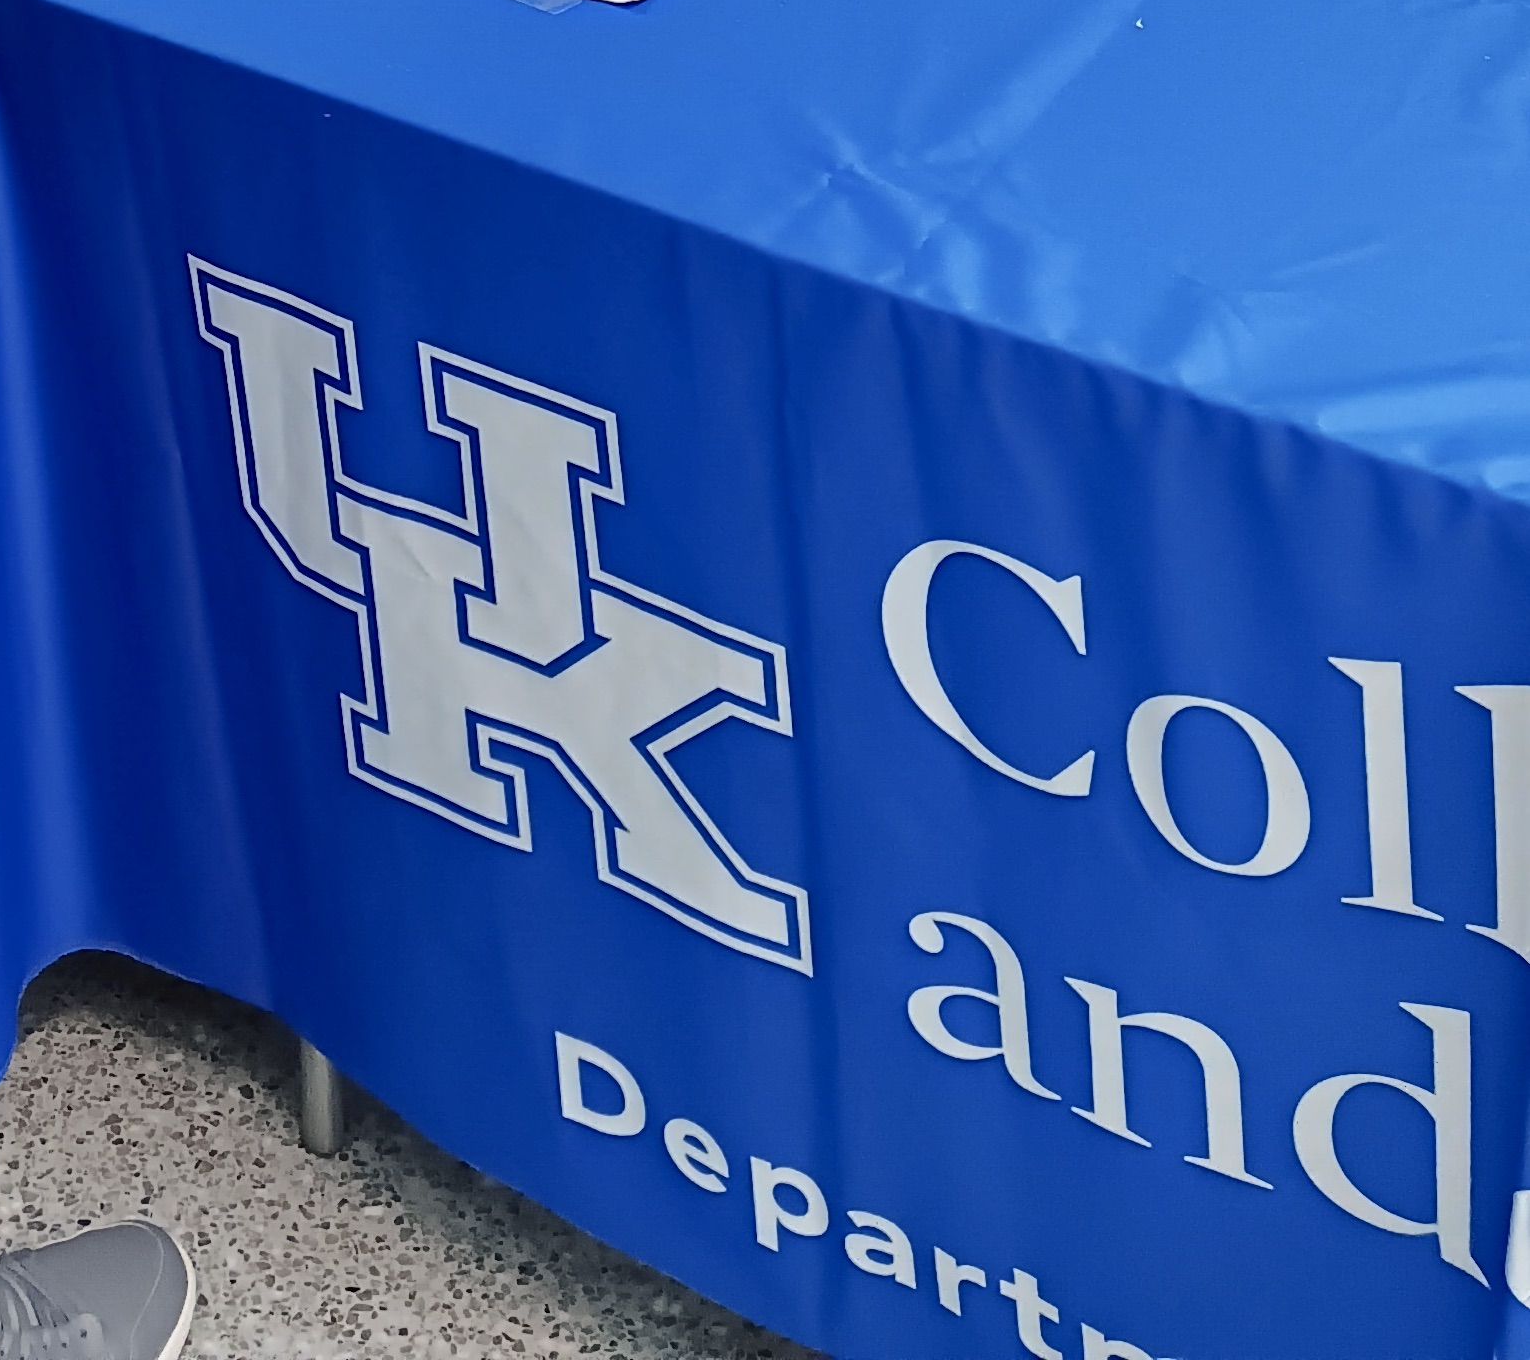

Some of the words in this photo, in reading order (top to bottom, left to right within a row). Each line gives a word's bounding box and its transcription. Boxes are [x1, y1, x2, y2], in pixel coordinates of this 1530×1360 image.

[187, 253, 815, 978] UK
[555, 1030, 1178, 1360] Depart
[907, 910, 1491, 1291] and
